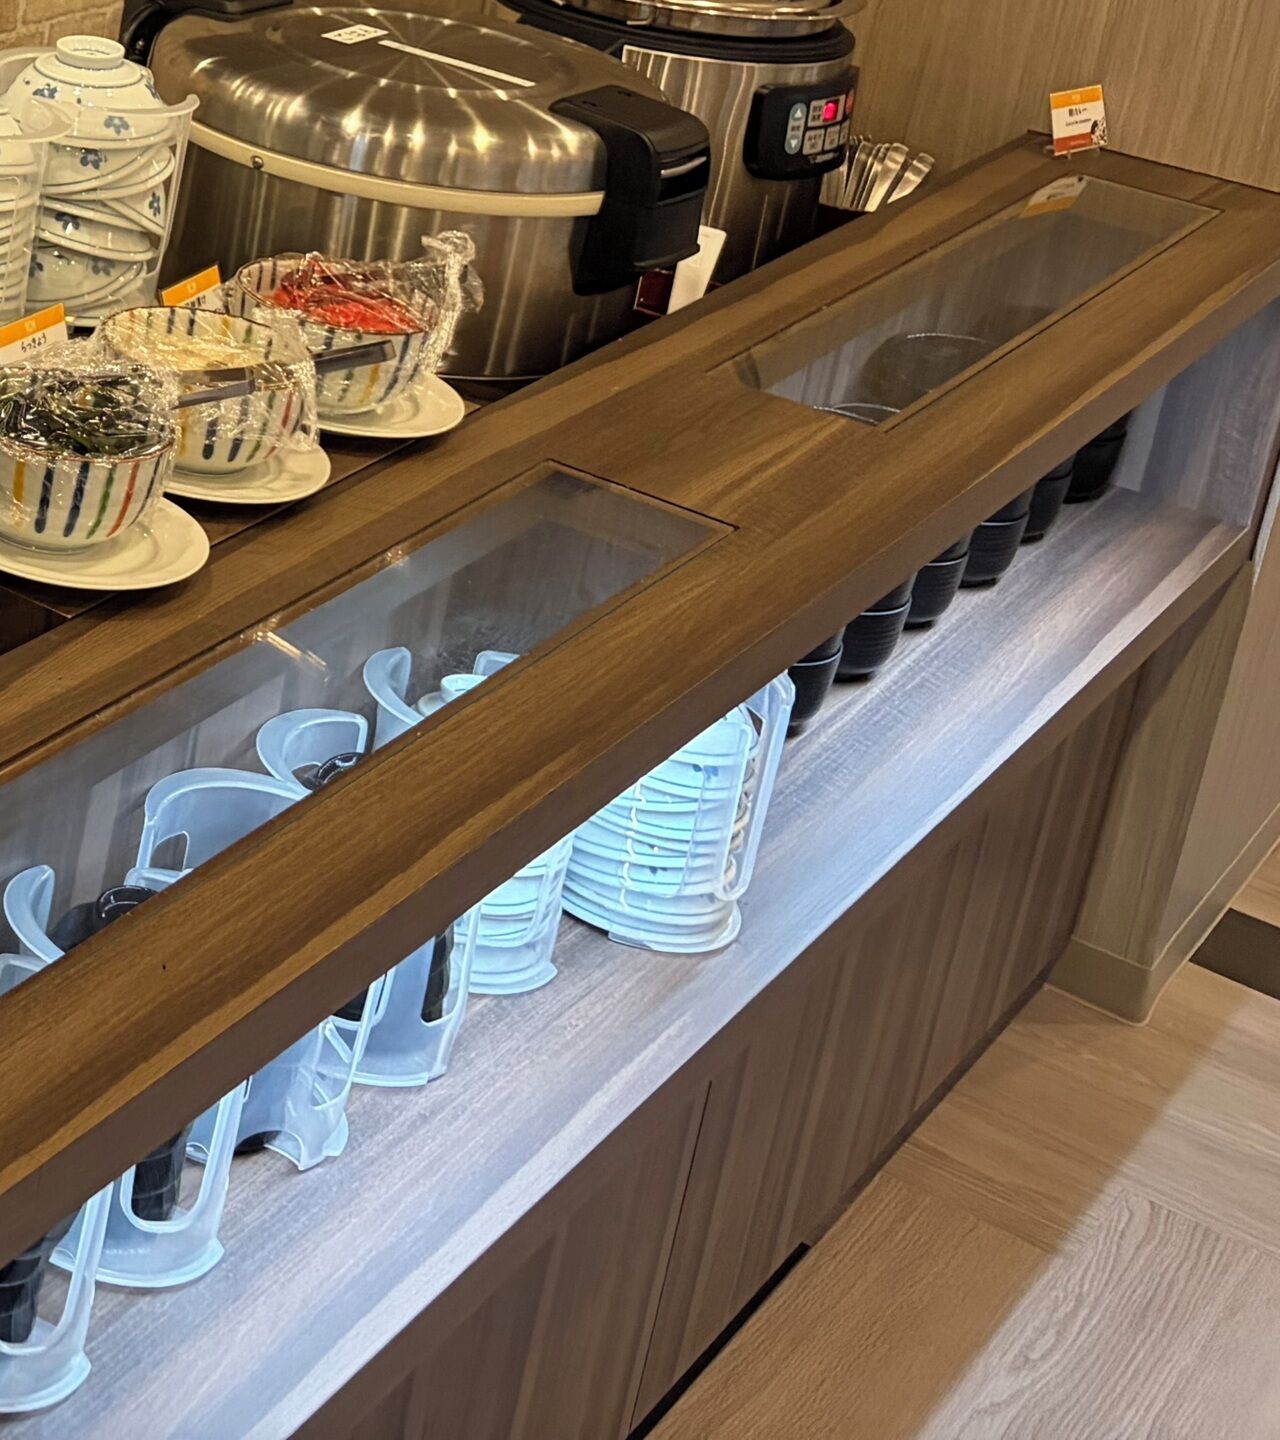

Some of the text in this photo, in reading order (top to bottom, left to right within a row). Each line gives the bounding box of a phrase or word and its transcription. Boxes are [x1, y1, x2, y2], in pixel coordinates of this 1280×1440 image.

[20, 332, 47, 353] らっきょう
